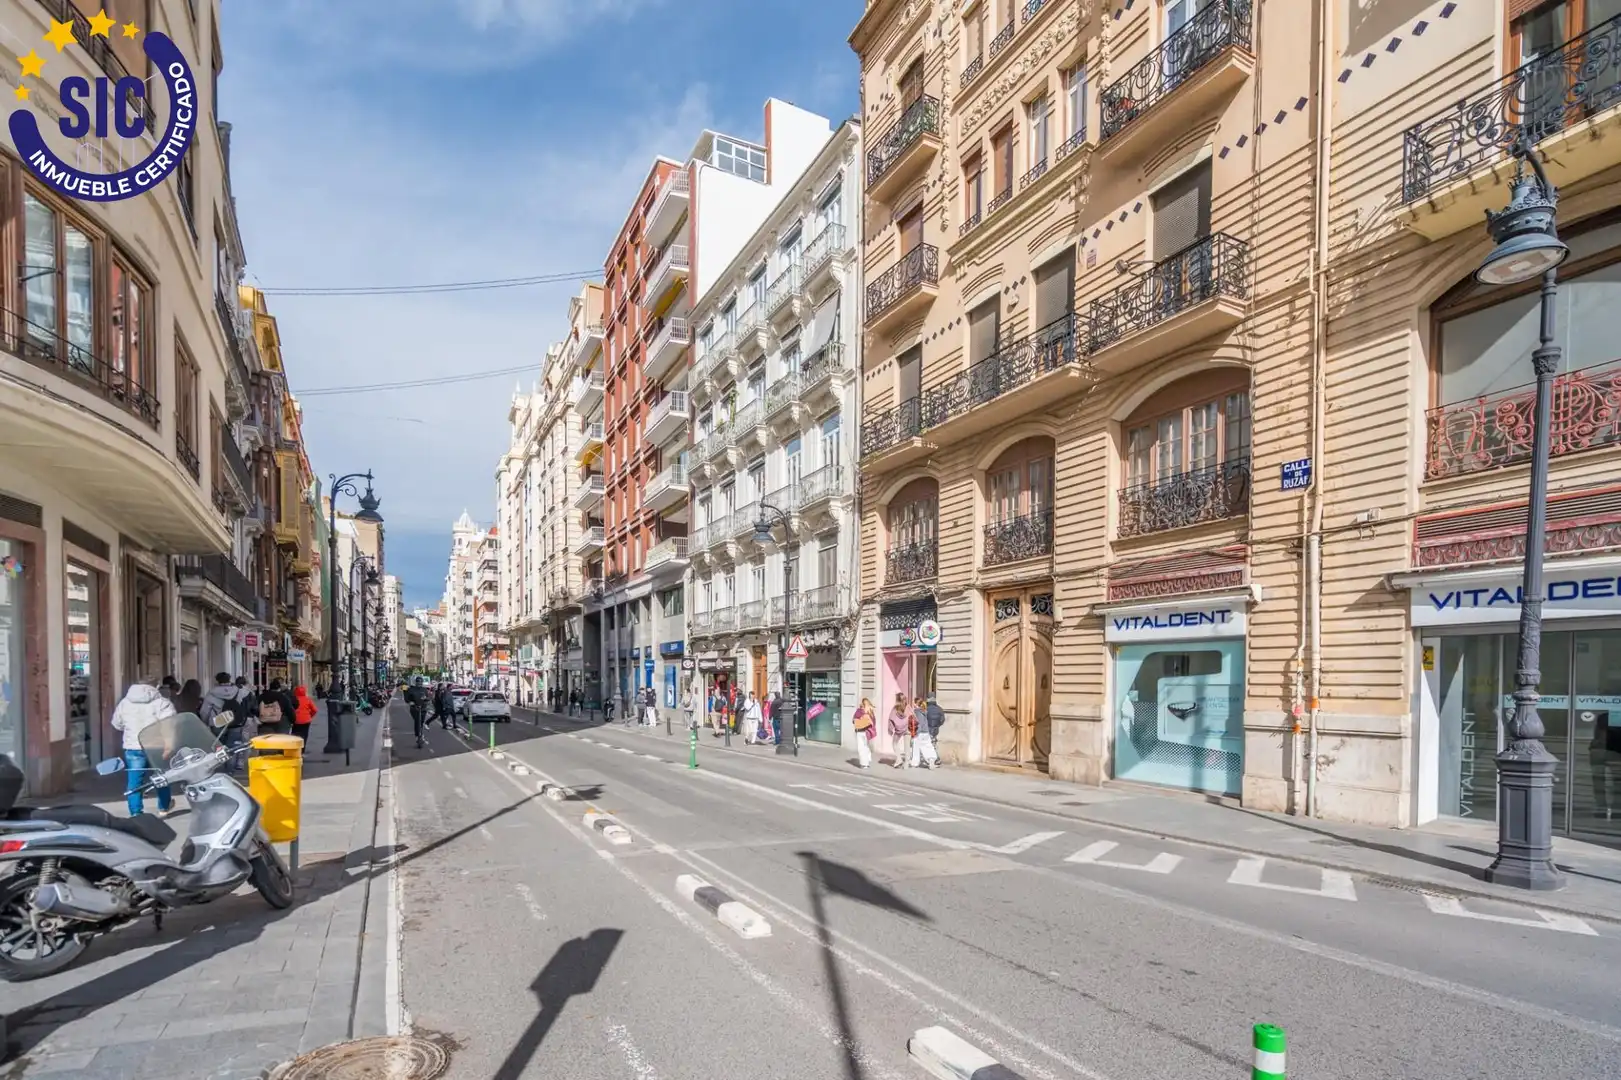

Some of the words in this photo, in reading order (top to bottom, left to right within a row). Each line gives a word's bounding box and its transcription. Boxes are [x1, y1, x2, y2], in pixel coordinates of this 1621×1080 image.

[1429, 576, 1621, 611] VITADE
[1113, 609, 1232, 631] VITALDENT
[1460, 707, 1476, 817] VITALDENT
